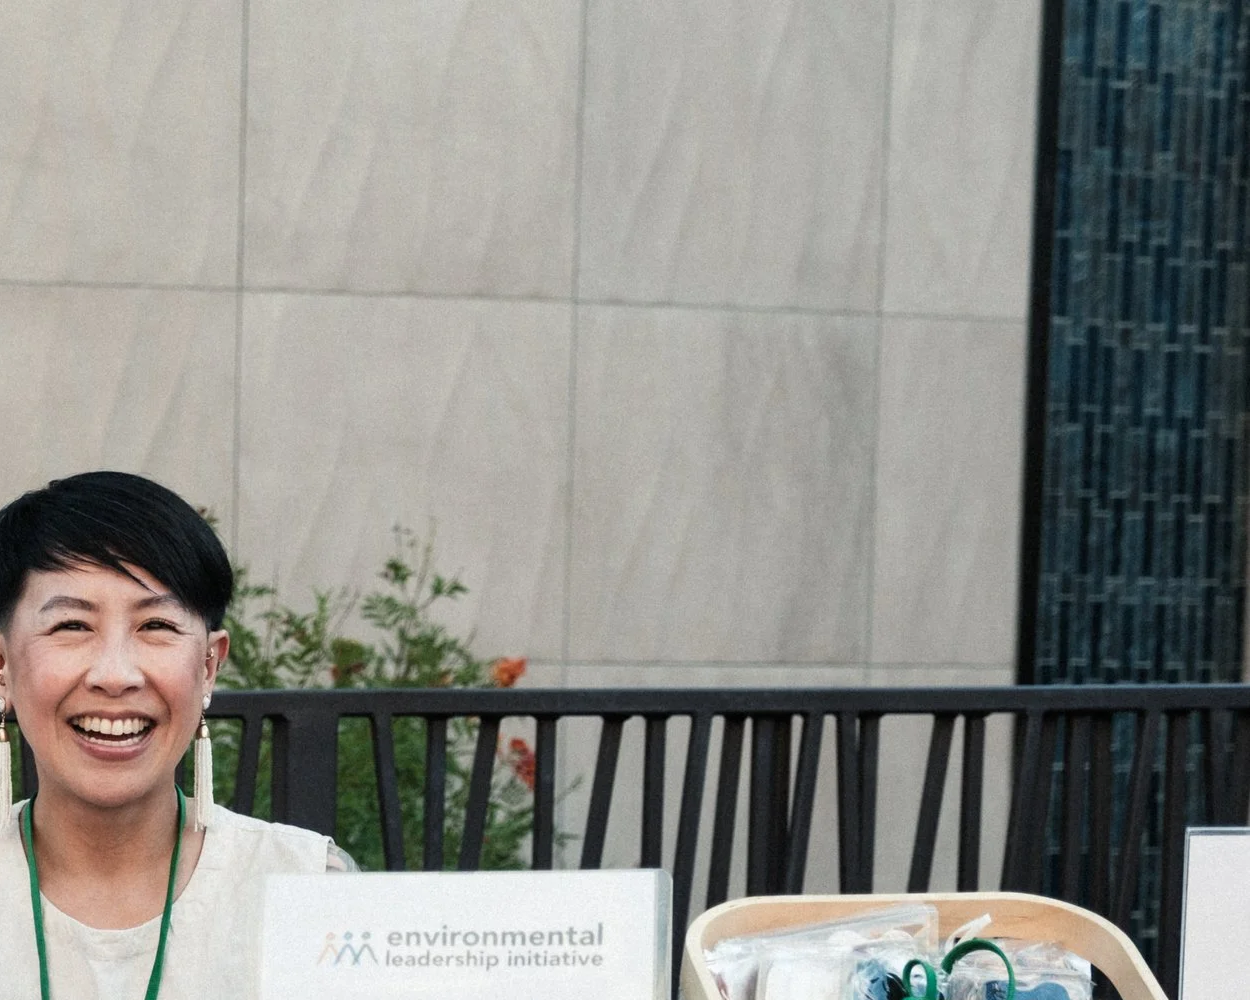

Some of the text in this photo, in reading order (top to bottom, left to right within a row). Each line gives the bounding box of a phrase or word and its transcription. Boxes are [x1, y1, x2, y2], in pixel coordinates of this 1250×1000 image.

[387, 923, 604, 947] environmental
[385, 950, 604, 972] leadership initiative
